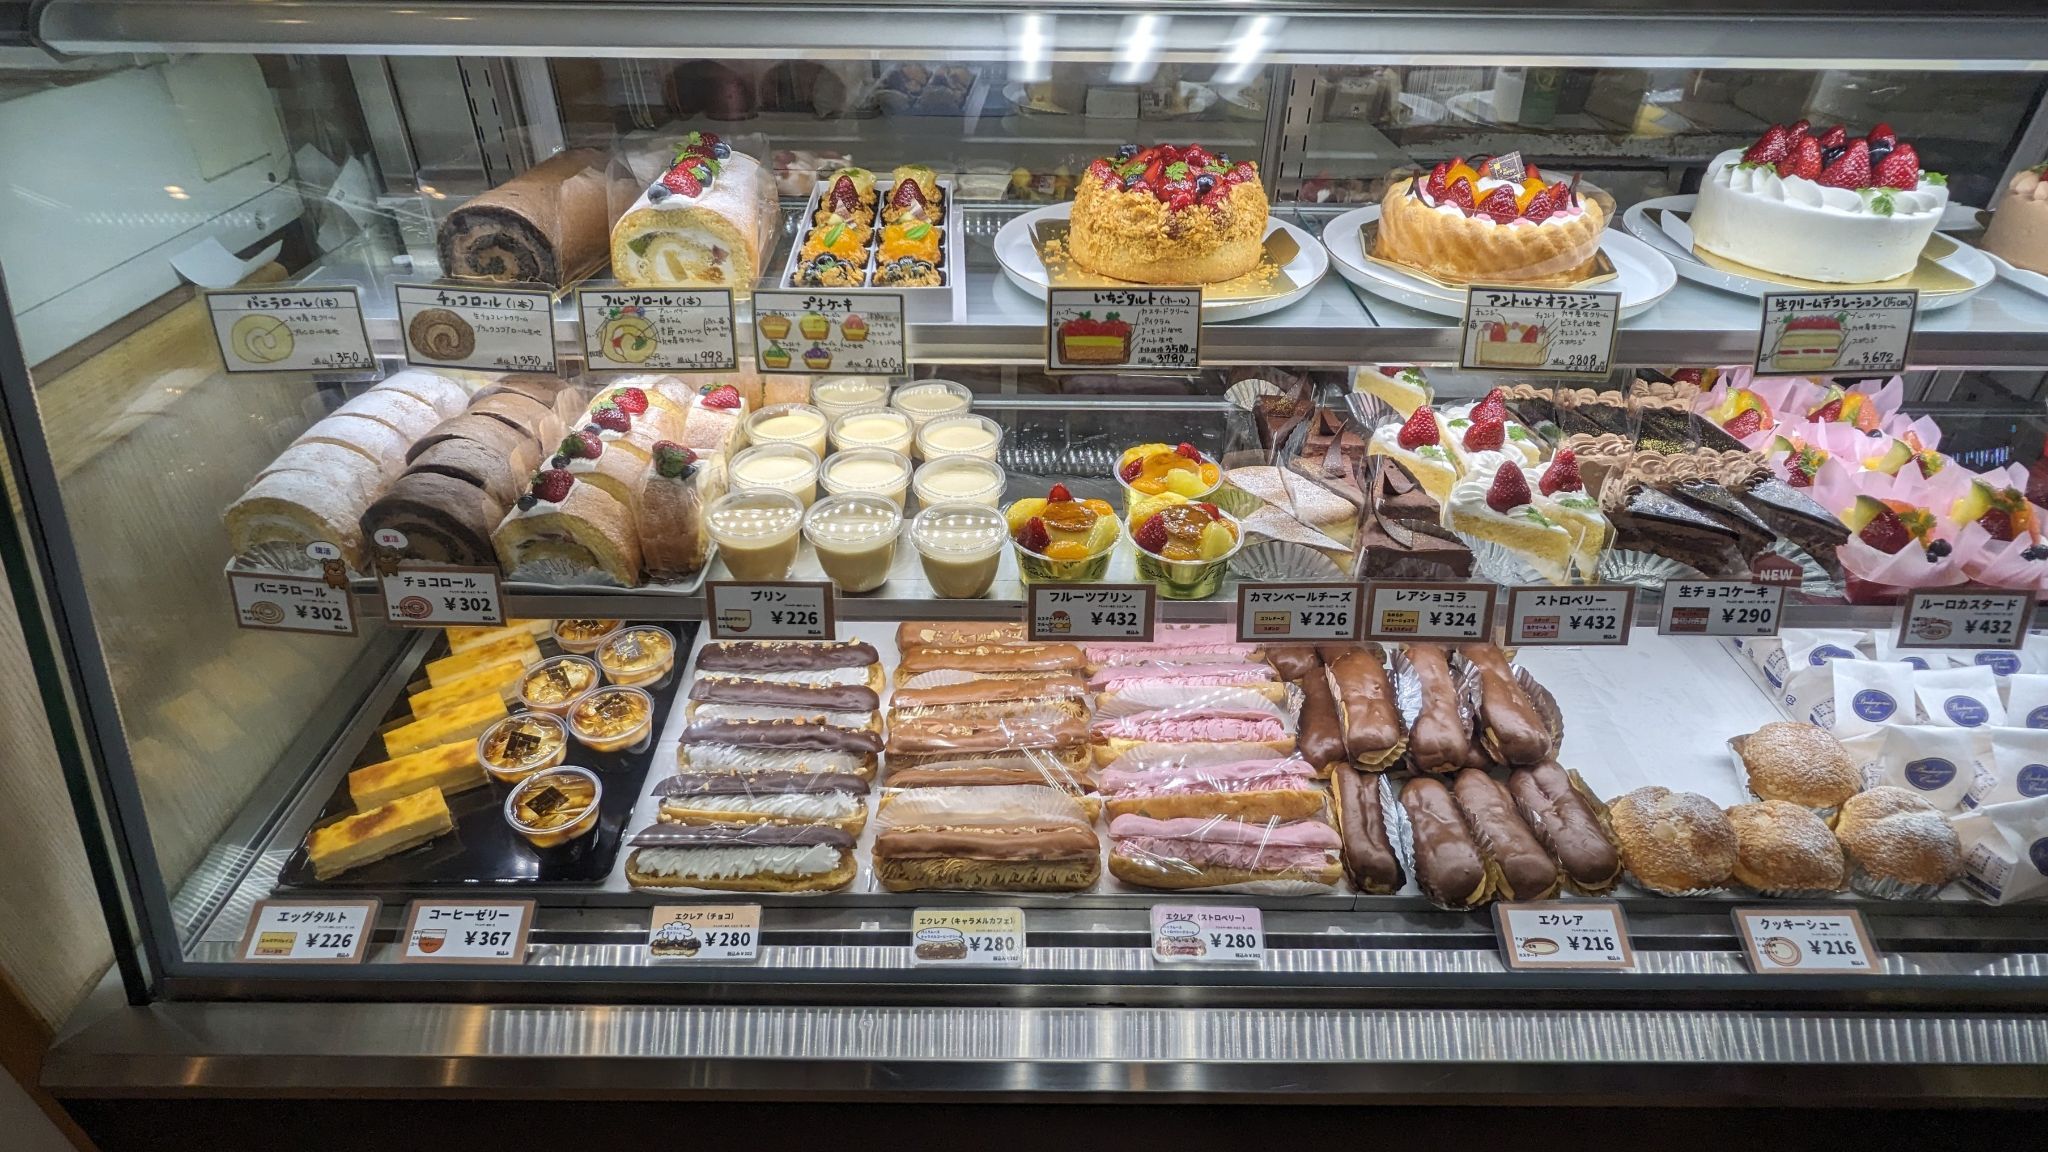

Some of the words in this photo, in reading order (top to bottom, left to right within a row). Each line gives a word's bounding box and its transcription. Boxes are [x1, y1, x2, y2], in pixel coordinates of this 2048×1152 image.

[802, 296, 852, 312] プチケーキ
[1486, 293, 1601, 309] アントルメオランジュ
[1165, 344, 1188, 353] 3500
[1157, 353, 1183, 363] 3780
[1568, 354, 1598, 366] 2808
[1759, 569, 1794, 581] NEW
[404, 577, 476, 588] チョコロール
[254, 582, 327, 598] バニラロール
[750, 590, 787, 602] プリン
[1396, 590, 1467, 603] レアショコラ
[1678, 585, 1769, 598] 生チョコケーキ
[1049, 592, 1132, 603] フルーツプリン
[1250, 591, 1352, 603] カマンベールチーズ
[1535, 595, 1607, 606] ストロベリー
[444, 597, 491, 612] ¥302
[1920, 599, 2019, 611] ルーロカスタード
[294, 604, 344, 621] ¥302
[770, 611, 818, 626] ¥226
[1091, 612, 1137, 626] ¥432
[1300, 611, 1348, 626] ¥226
[1429, 611, 1477, 627] ¥324
[1721, 608, 1772, 624] ¥290
[1569, 615, 1616, 630] ¥432
[1964, 620, 2013, 634] ¥432
[276, 911, 348, 923] エッグタルト
[429, 909, 510, 921] コーヒーゼリー
[675, 912, 735, 922] エクレア（チョコ）
[919, 917, 1014, 926] エクレア（キャラメルカフェ）
[1165, 913, 1246, 923] エクレア（ストロベリー）
[1538, 914, 1584, 926] エクレア
[1760, 918, 1841, 931] クッキーシュー
[305, 932, 353, 948] ¥226
[464, 930, 512, 947] ¥367
[705, 931, 751, 947] ¥280
[969, 936, 1016, 952] ¥280
[1210, 933, 1257, 949] ¥280
[1566, 935, 1615, 951] ¥216
[1808, 939, 1857, 955] ¥216
